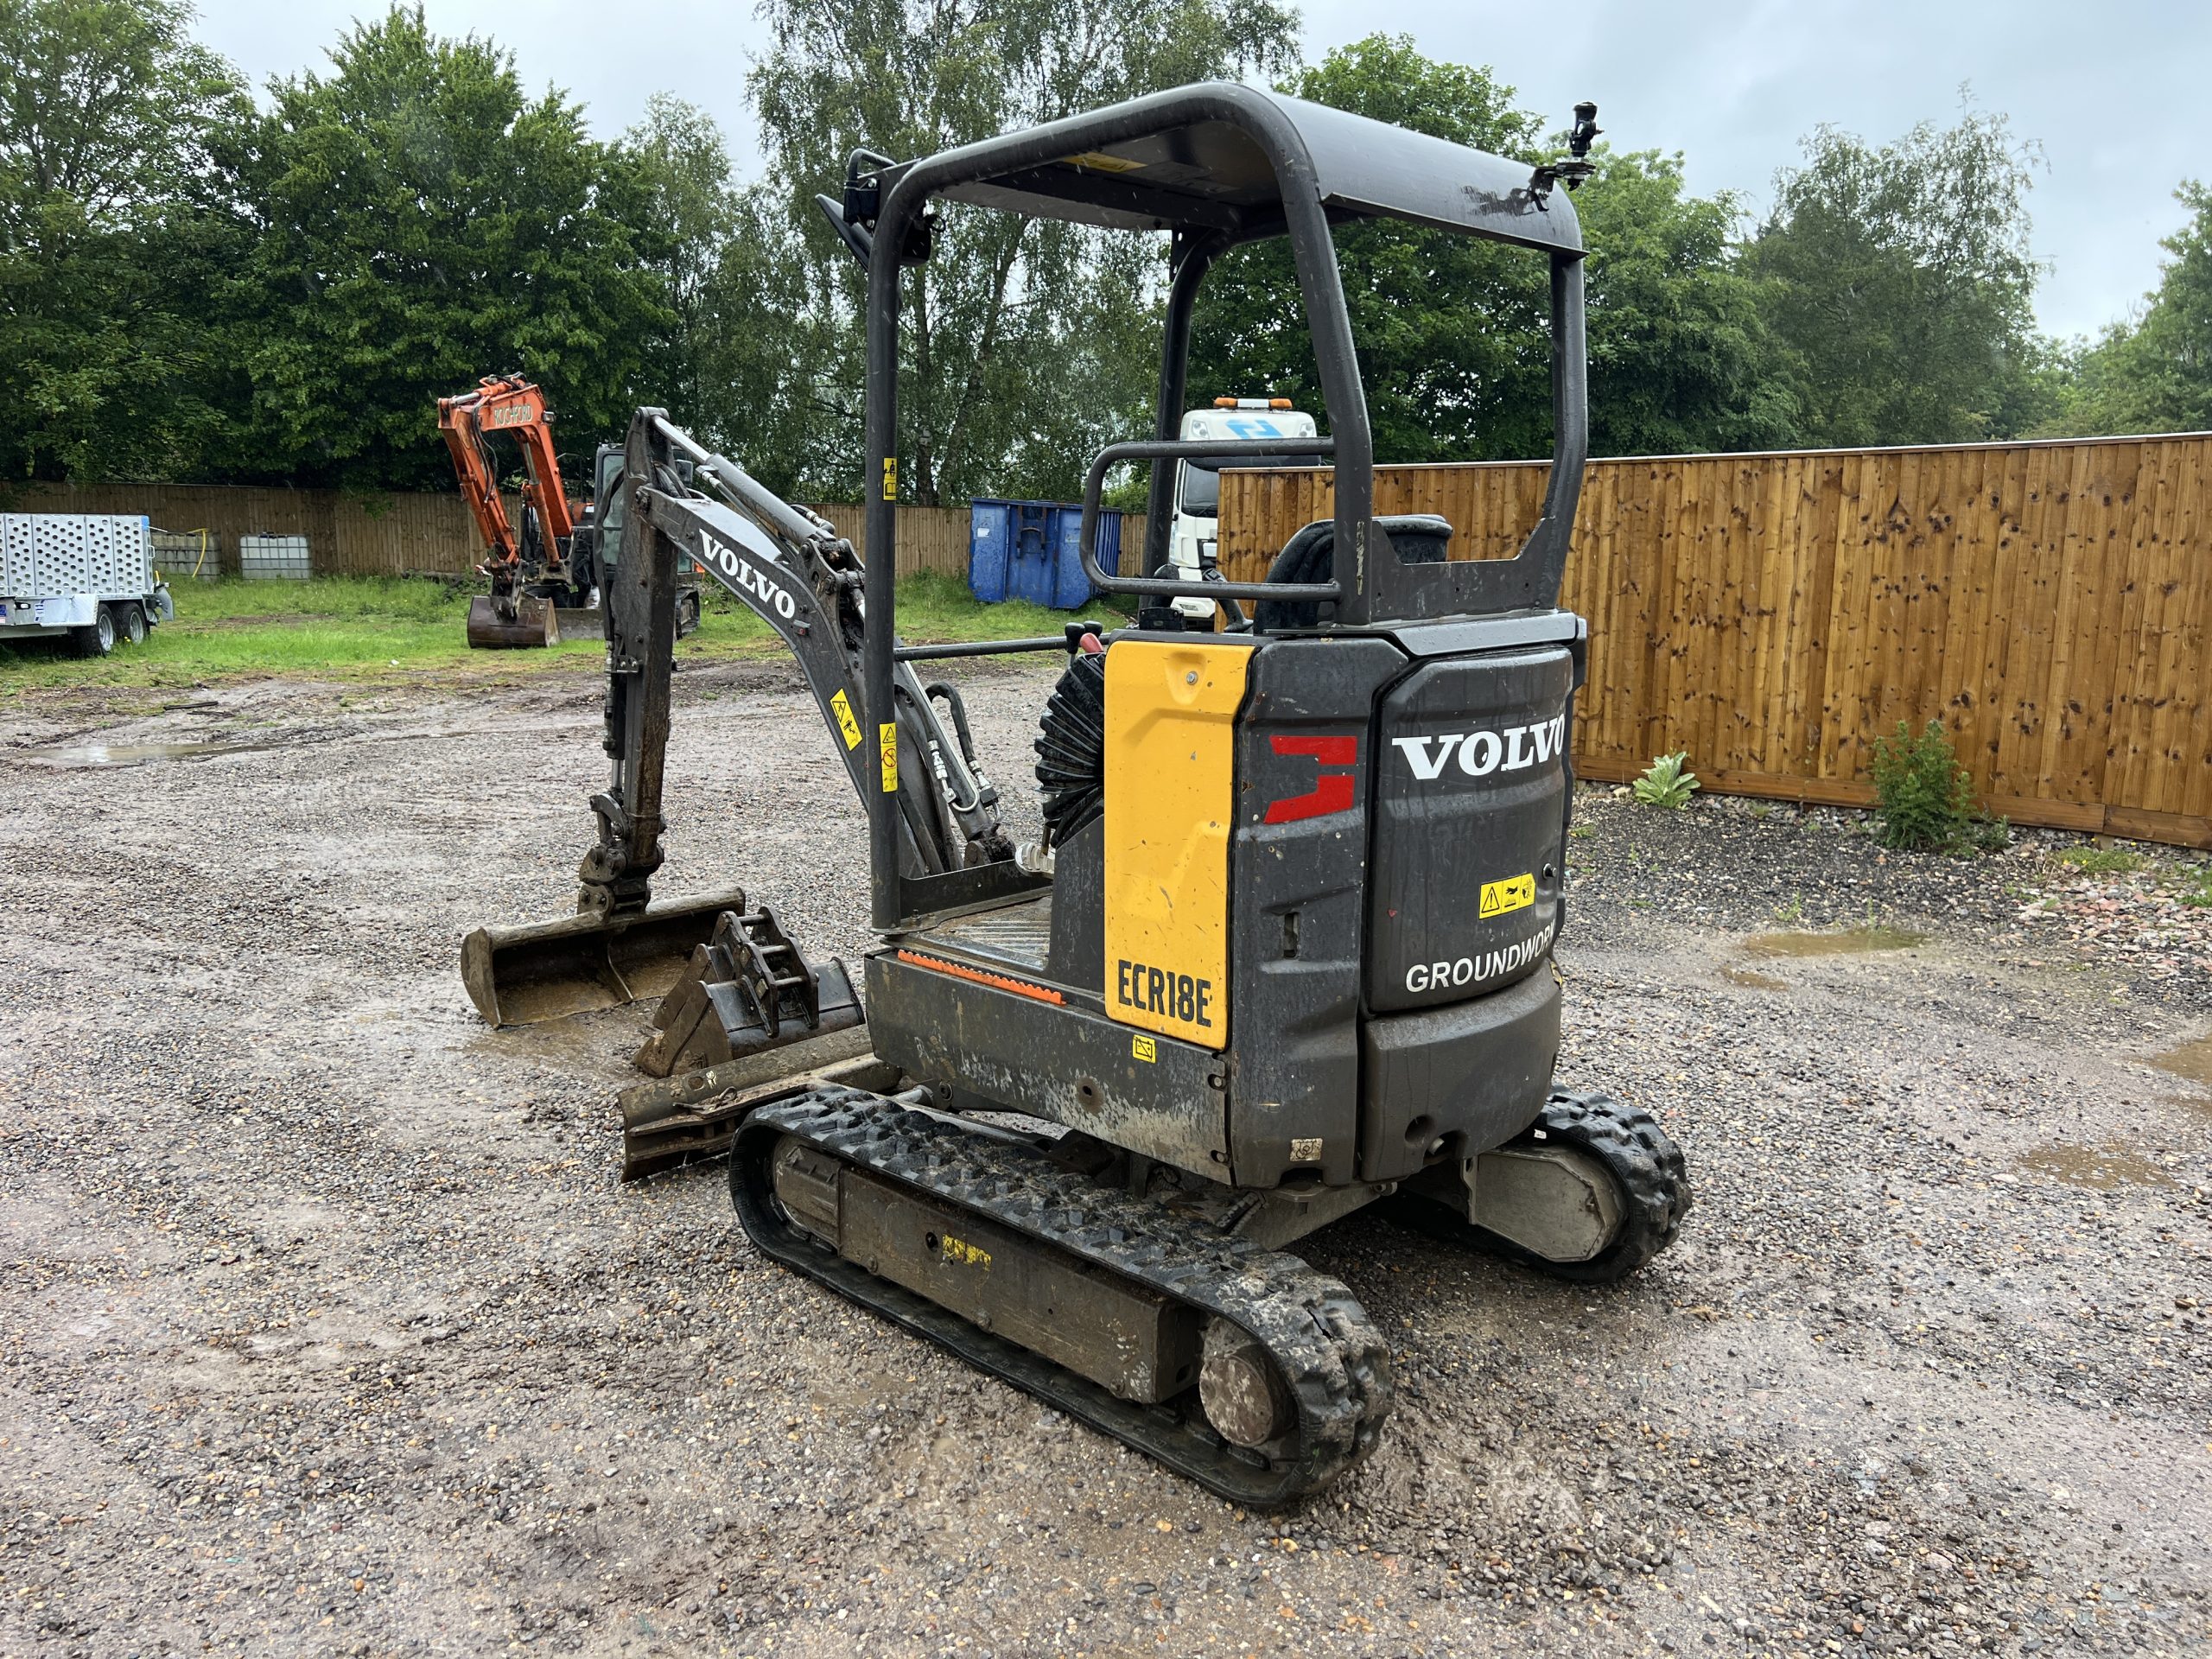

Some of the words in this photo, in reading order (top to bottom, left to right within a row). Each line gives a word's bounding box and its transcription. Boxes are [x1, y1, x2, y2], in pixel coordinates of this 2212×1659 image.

[494, 404, 533, 427] ROCHFORD
[699, 528, 795, 619] VOLVO
[1392, 713, 1565, 779] VOLVO
[1118, 958, 1211, 1027] ECR18E
